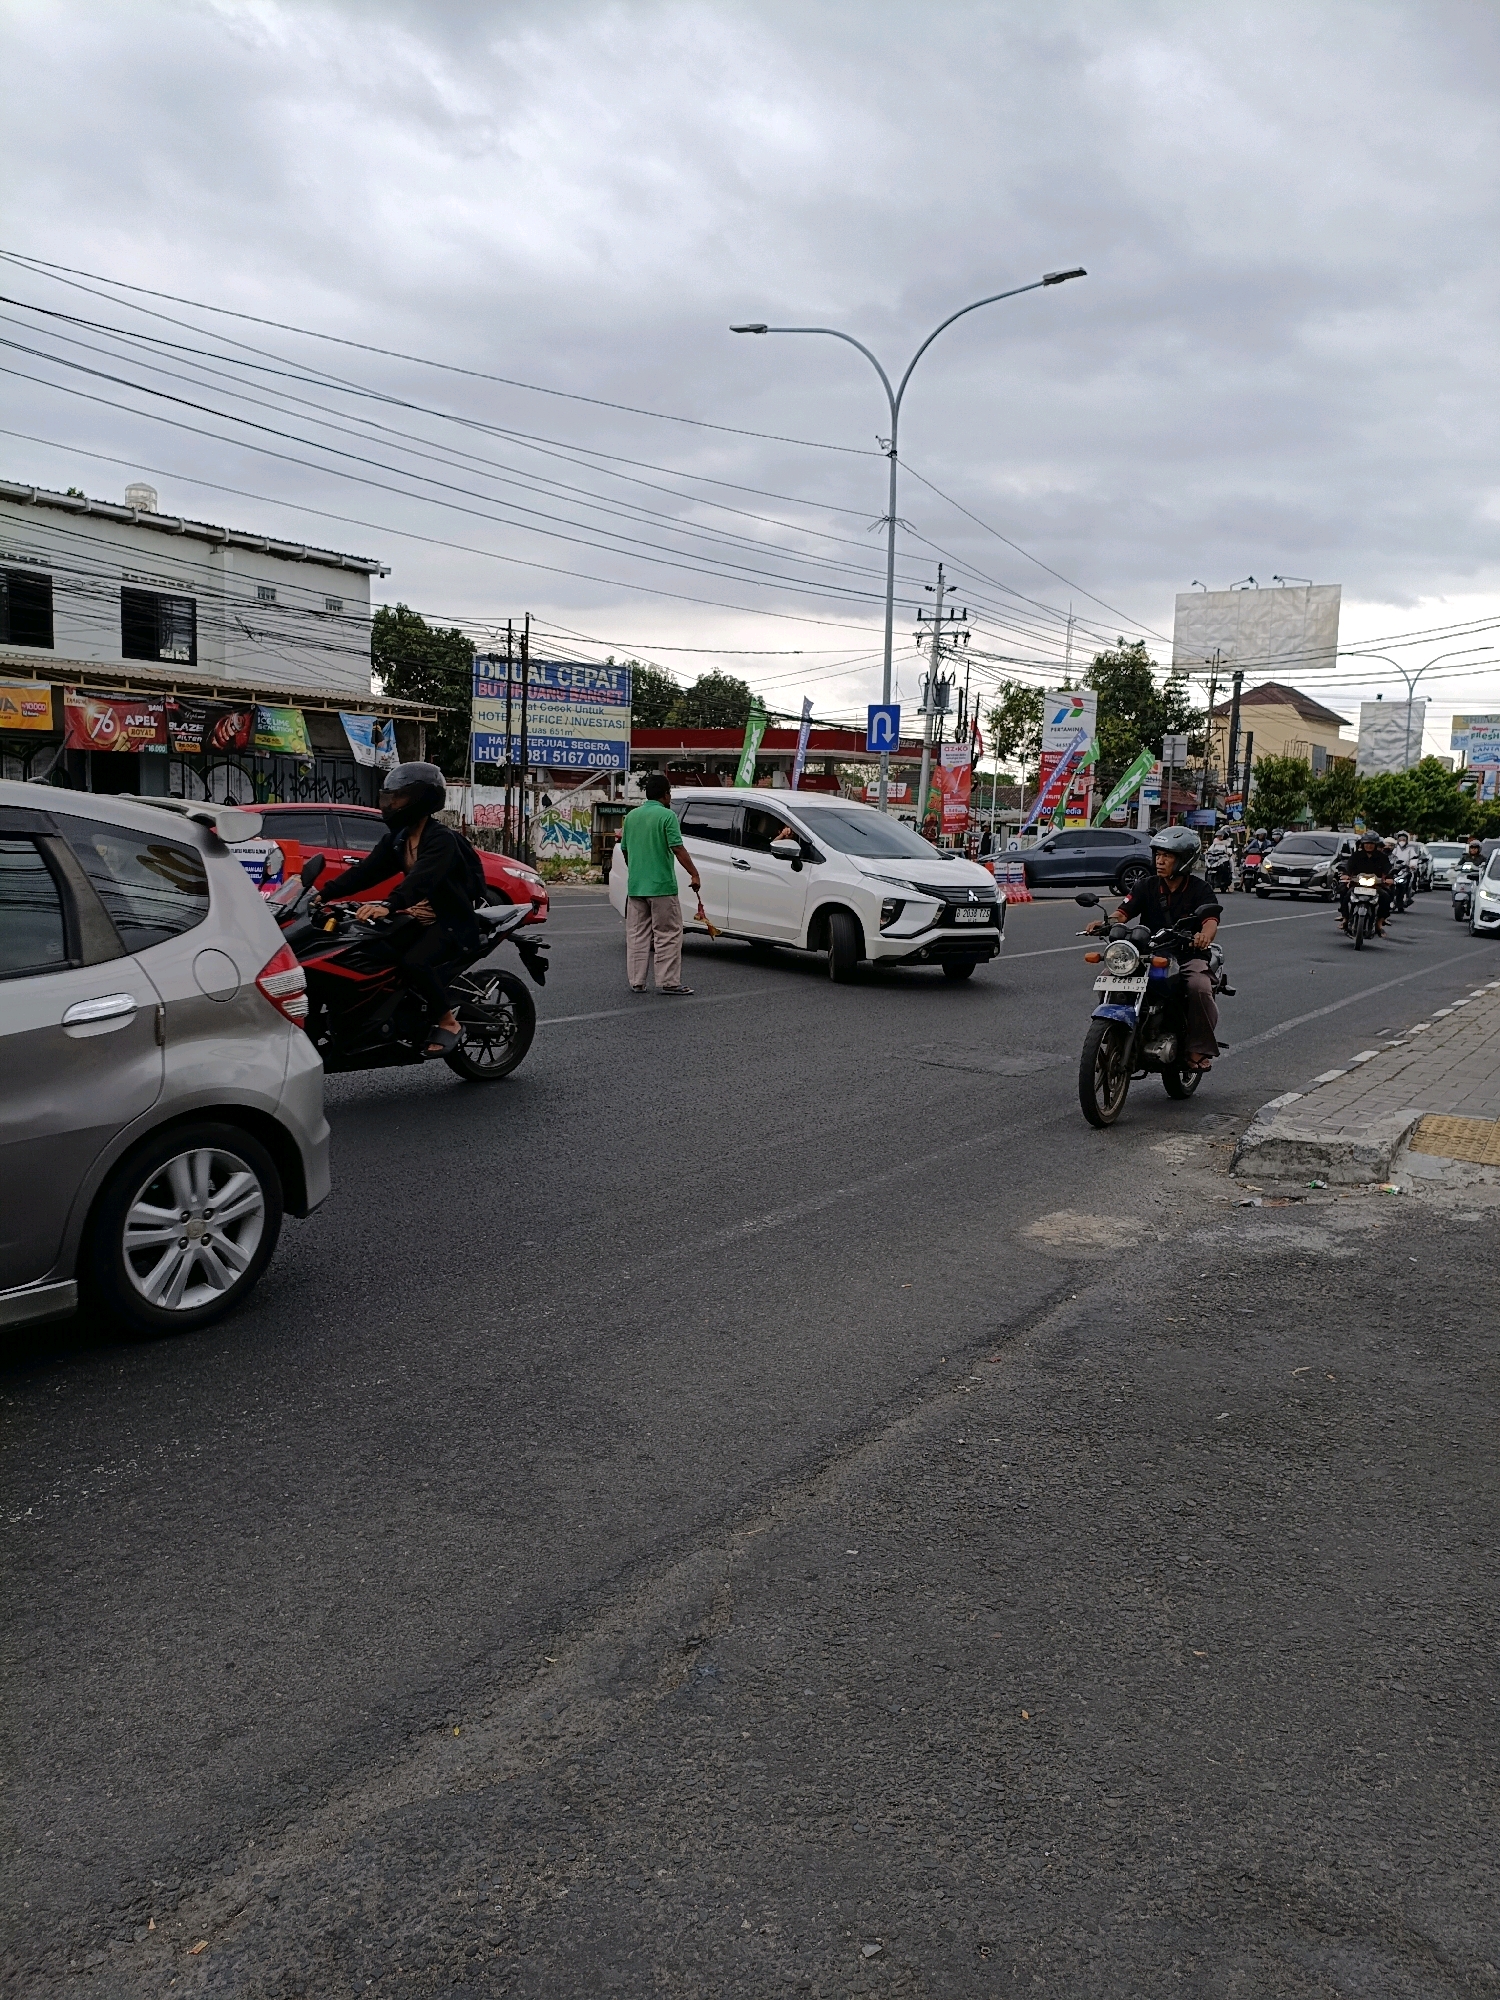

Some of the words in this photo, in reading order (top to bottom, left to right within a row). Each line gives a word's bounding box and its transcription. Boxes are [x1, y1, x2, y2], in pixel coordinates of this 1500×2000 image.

[480, 661, 553, 684] DIJUAL
[557, 666, 622, 689] CEPAT
[527, 685, 567, 700] UANG
[570, 687, 623, 704] BANGET
[501, 701, 537, 711] Snat
[540, 703, 571, 713] Cocok
[576, 705, 604, 715] Untuk
[91, 707, 115, 739] 76
[125, 714, 158, 727] APEL
[168, 721, 205, 732] BLAZE
[257, 716, 272, 725] ICE
[571, 717, 625, 729] INVESTASI
[130, 729, 154, 737] ROYAL
[526, 739, 569, 749] TERJUAL
[571, 741, 611, 751] SEGERA
[553, 750, 584, 764] 5167
[588, 753, 620, 767] 0009
